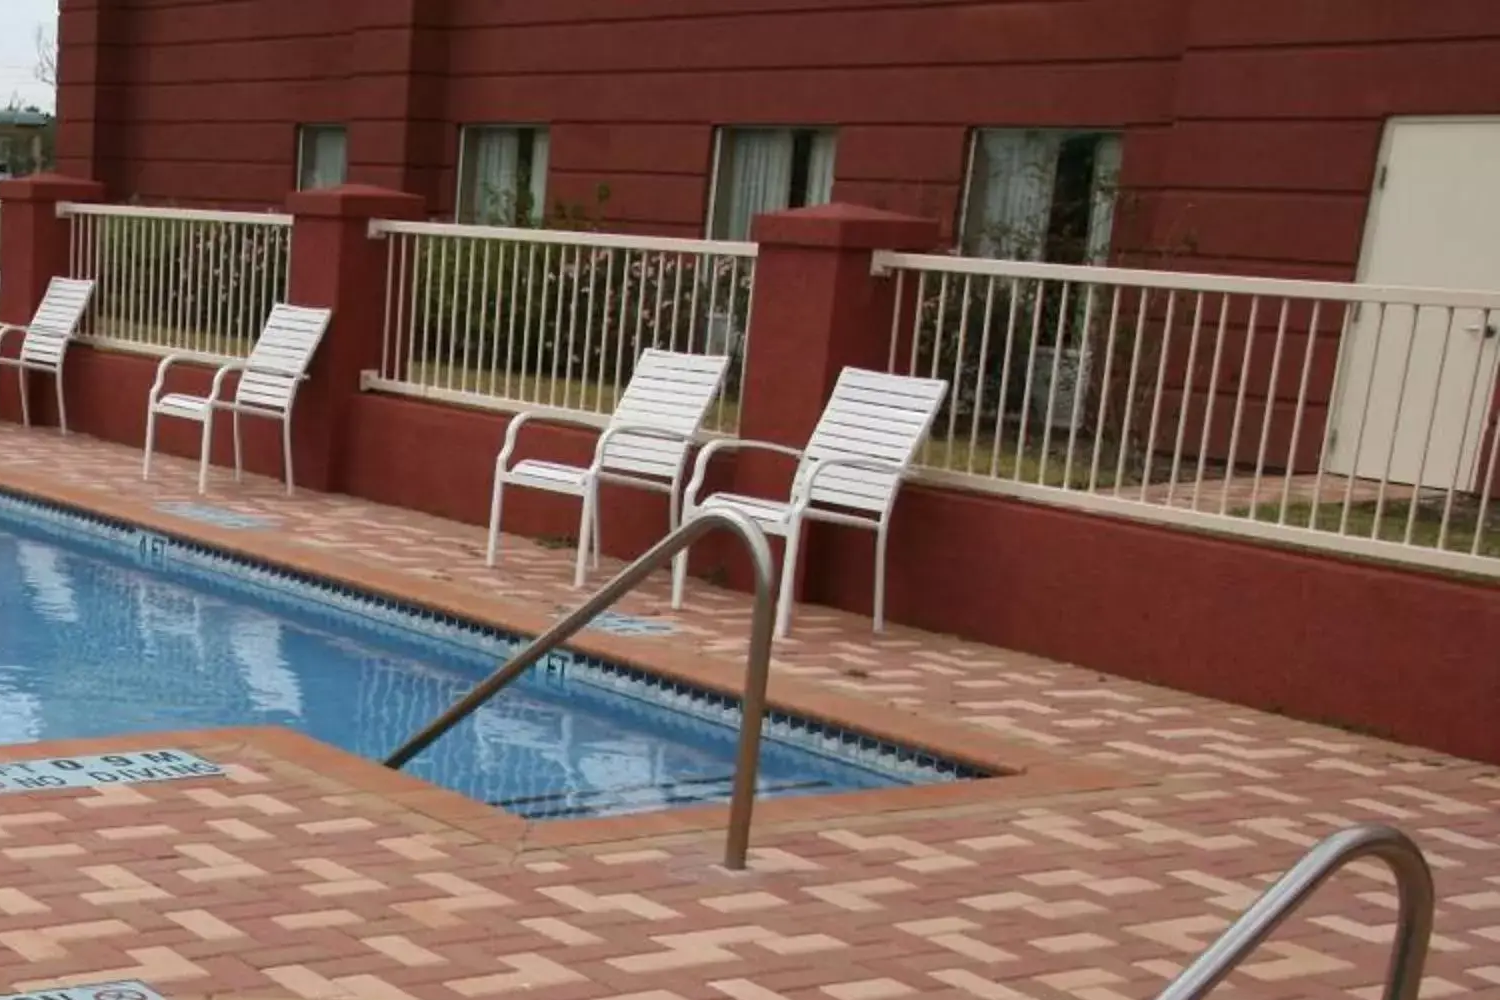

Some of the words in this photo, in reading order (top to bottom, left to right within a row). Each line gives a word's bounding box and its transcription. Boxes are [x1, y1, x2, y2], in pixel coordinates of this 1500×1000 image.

[140, 751, 182, 764] M
[11, 775, 67, 789] NO
[86, 761, 221, 783] DIVING
